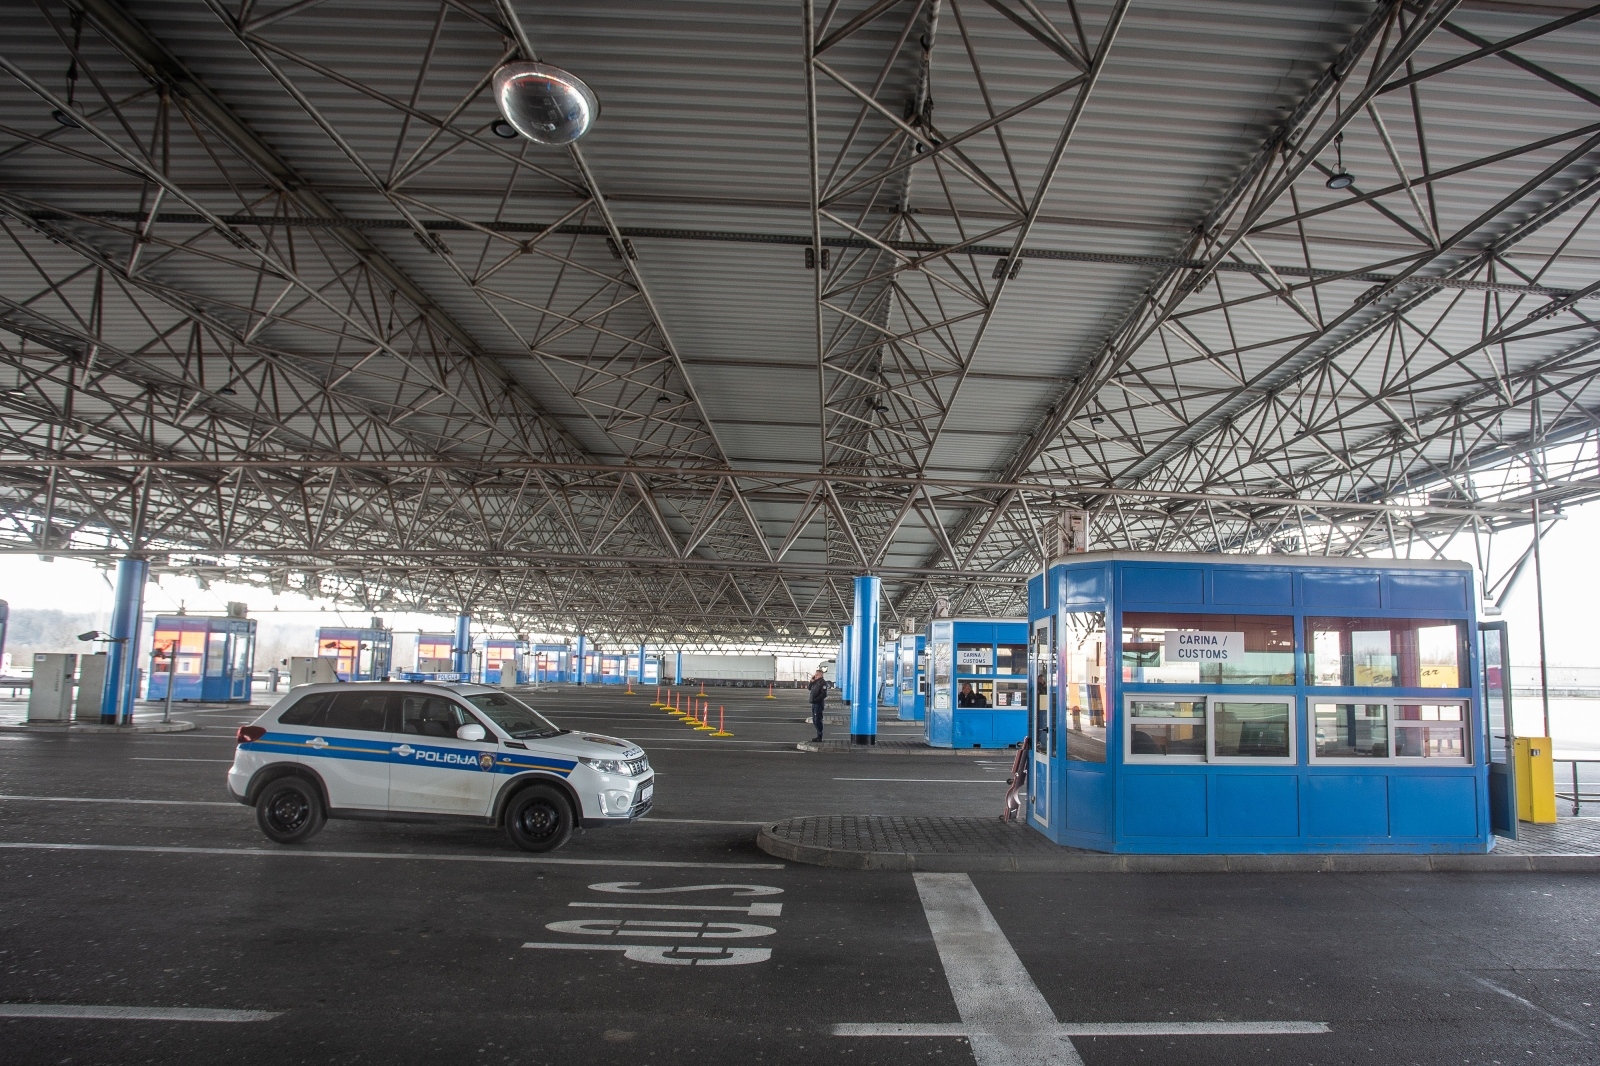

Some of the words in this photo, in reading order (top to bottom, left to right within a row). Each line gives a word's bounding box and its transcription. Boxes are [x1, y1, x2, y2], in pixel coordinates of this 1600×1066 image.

[1179, 634, 1218, 645] CARINA
[1222, 635, 1228, 647] /
[1178, 648, 1228, 659] CUSTOMS
[415, 750, 479, 766] POLICIJA
[521, 881, 785, 966] STOP
